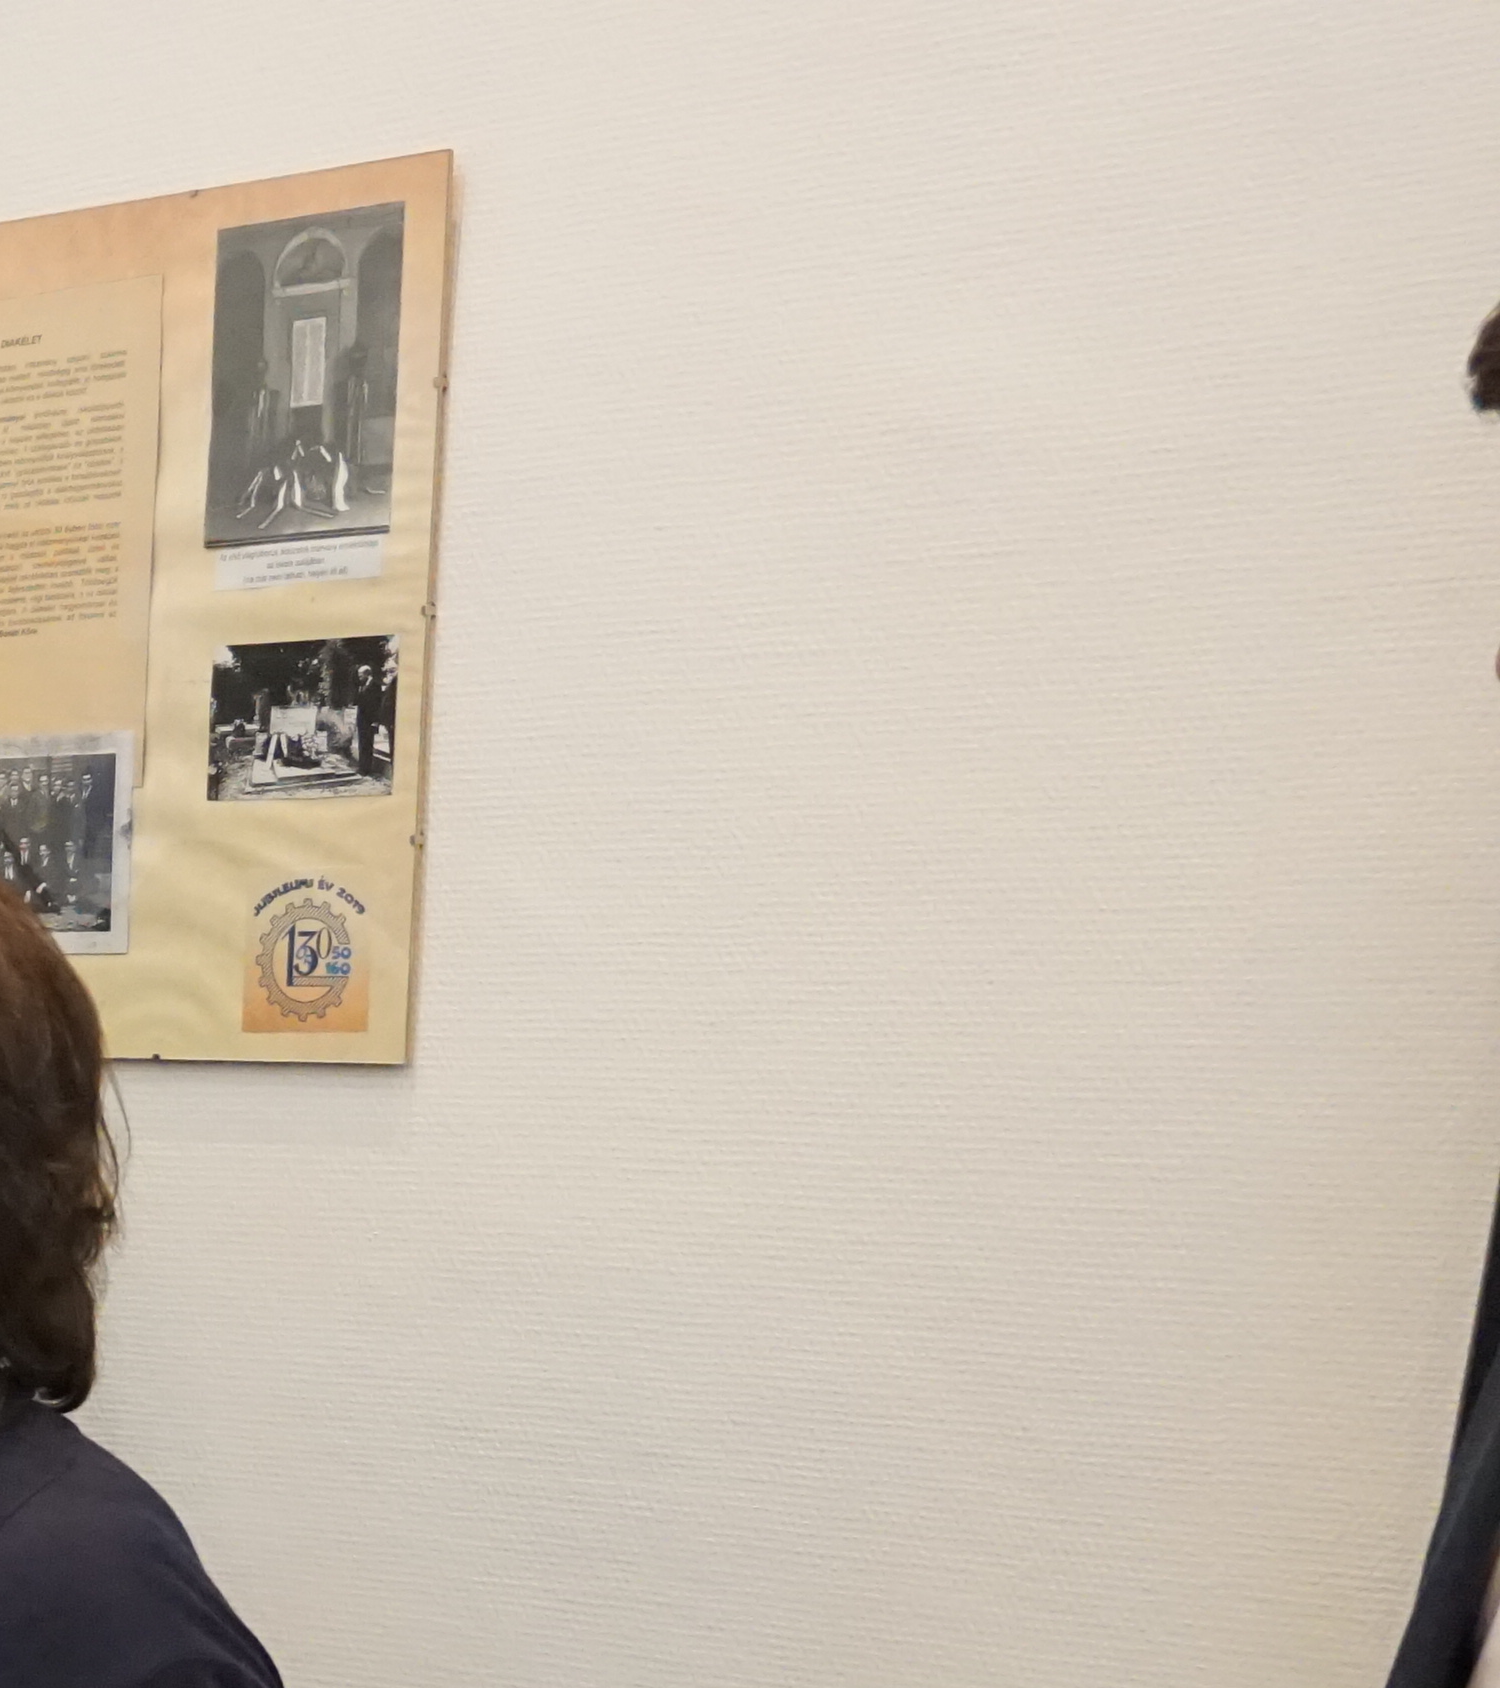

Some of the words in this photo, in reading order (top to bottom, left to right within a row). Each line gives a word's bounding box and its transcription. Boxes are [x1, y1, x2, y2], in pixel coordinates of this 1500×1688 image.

[253, 877, 314, 917] JUBILEUMI
[317, 875, 335, 892] ÉV
[336, 887, 366, 916] 2019
[282, 922, 332, 987] 130
[332, 945, 352, 960] 50
